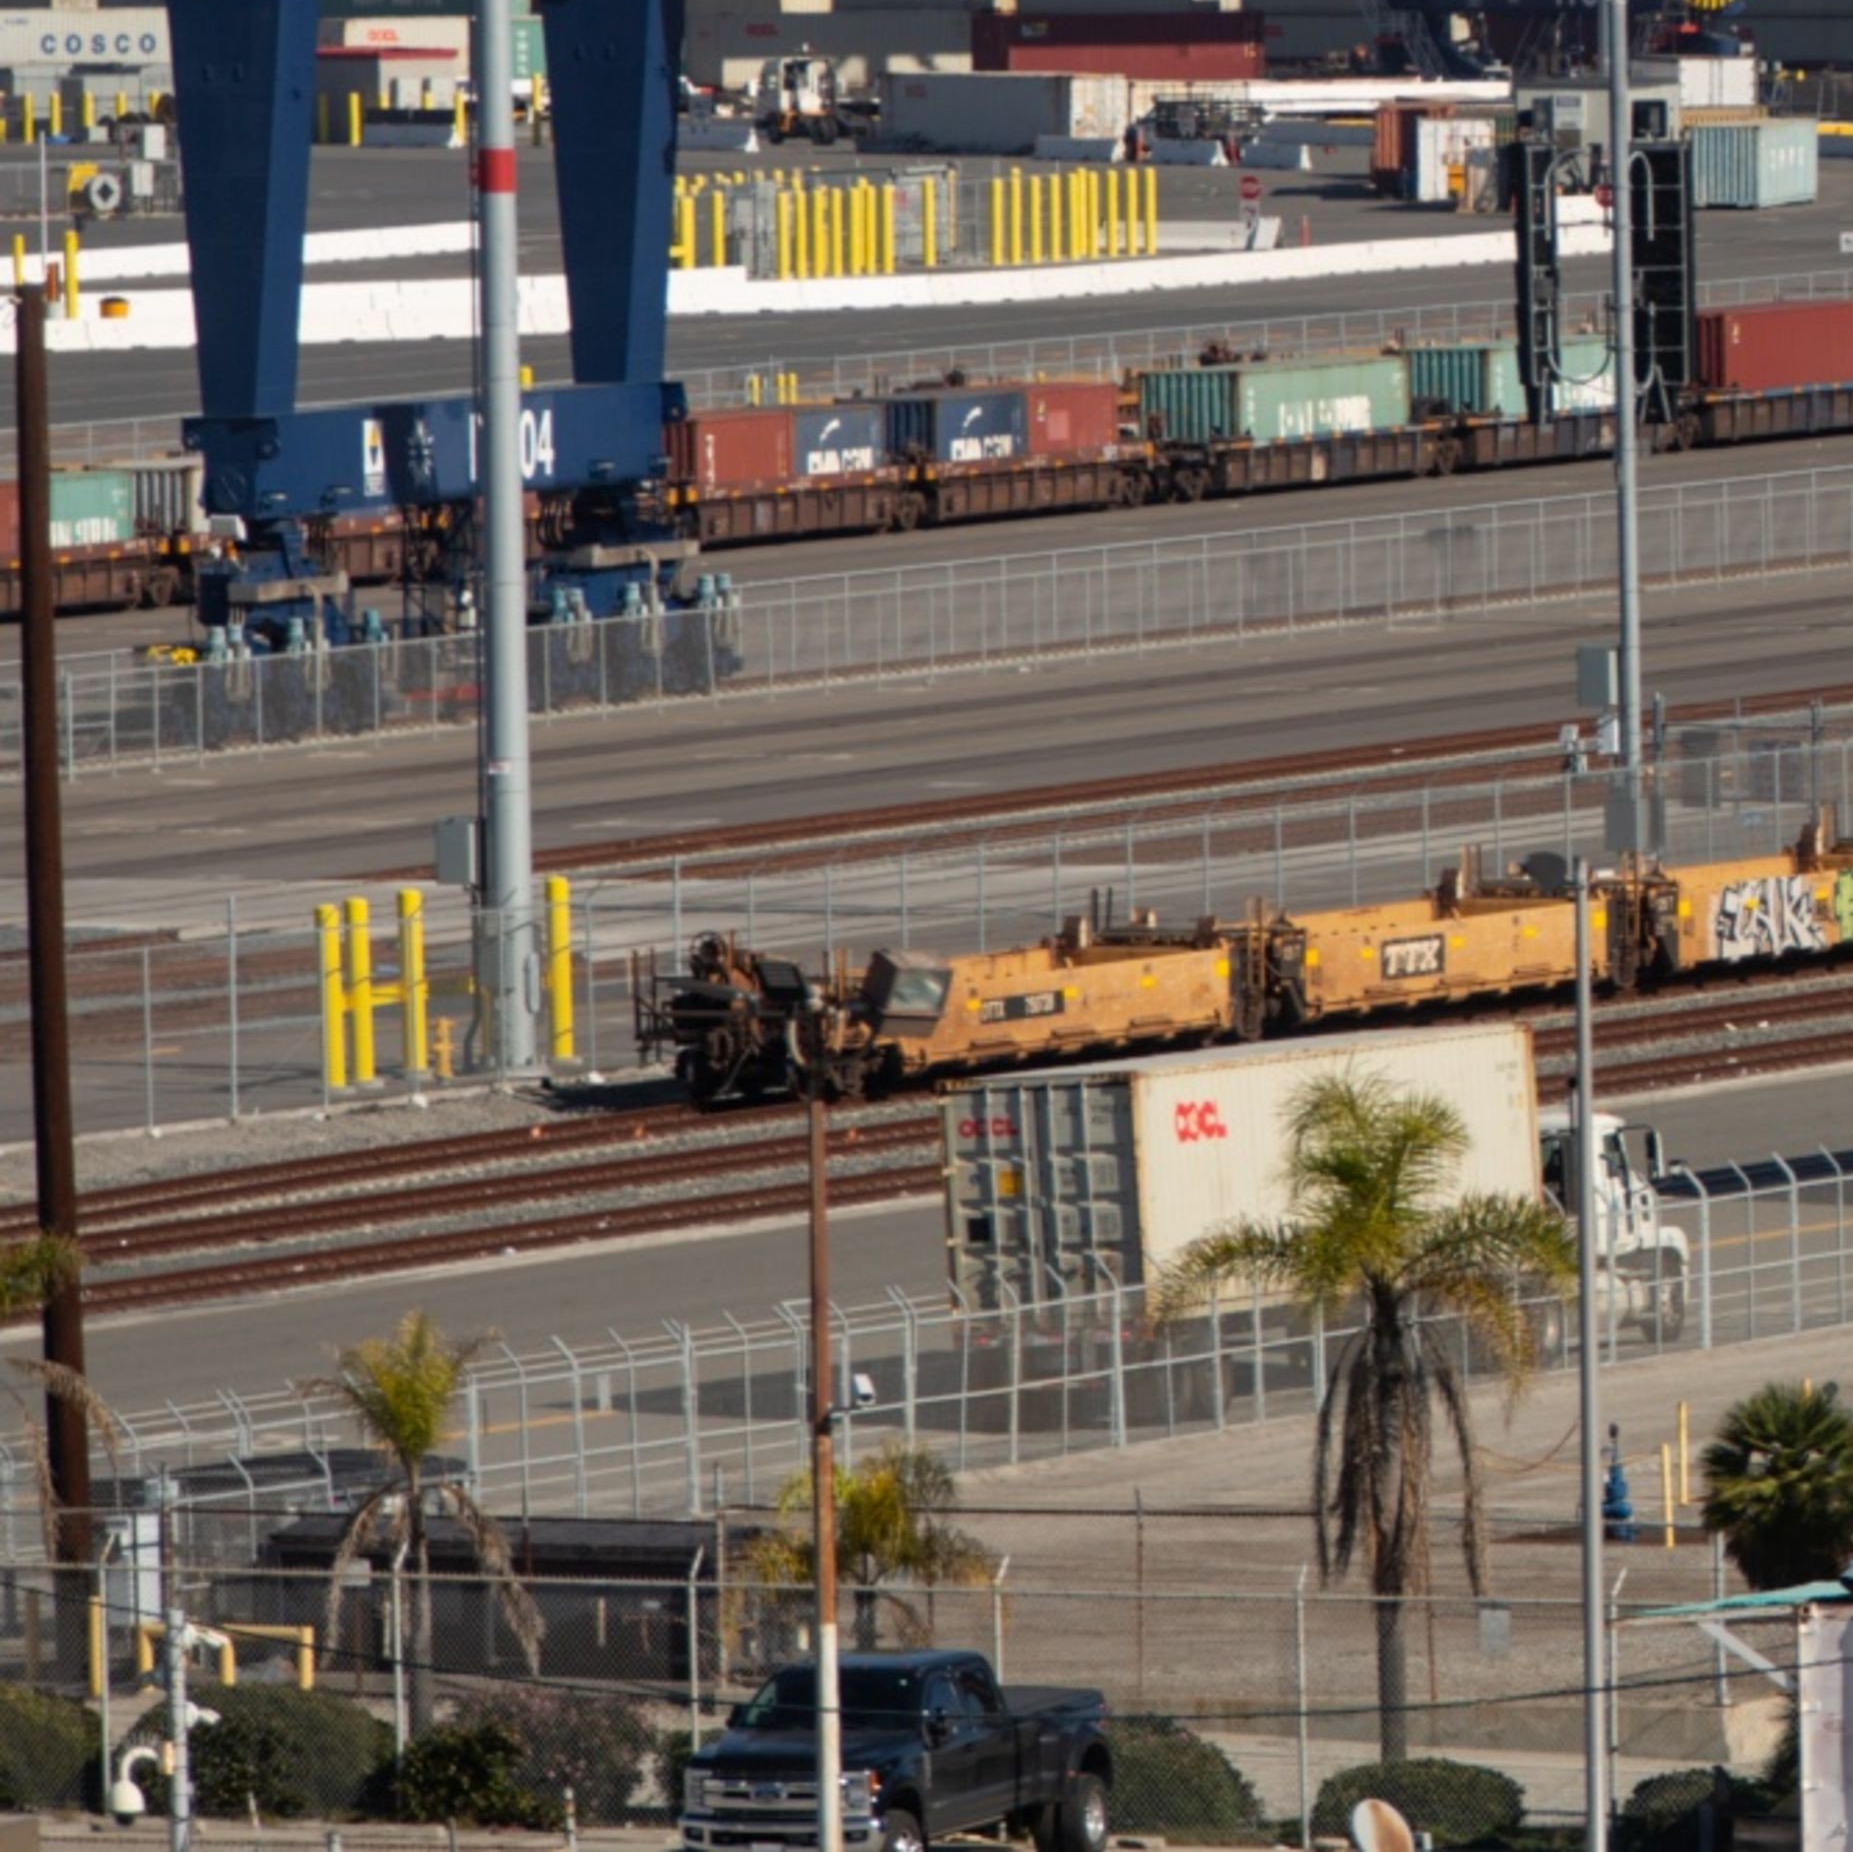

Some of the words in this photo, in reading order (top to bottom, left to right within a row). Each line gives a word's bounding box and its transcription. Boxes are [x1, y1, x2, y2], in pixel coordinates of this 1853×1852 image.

[40, 34, 157, 55] COSCO
[519, 409, 555, 480] 04
[1383, 939, 1442, 977] TTX
